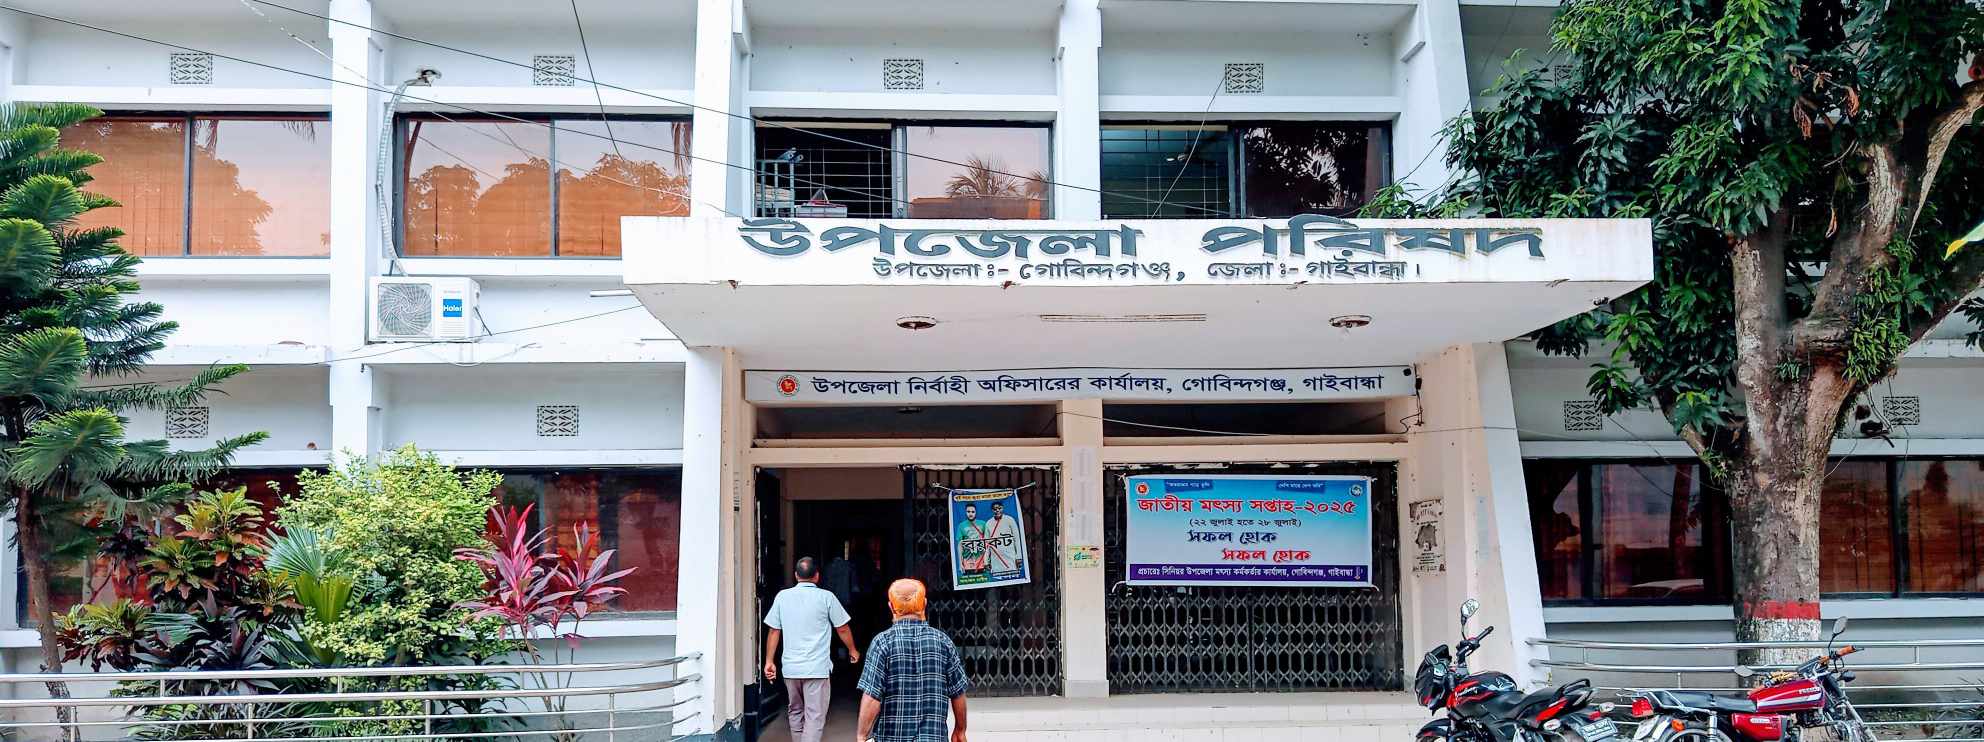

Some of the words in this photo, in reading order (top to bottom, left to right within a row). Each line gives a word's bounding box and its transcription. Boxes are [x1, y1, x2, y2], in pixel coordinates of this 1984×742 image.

[738, 217, 1144, 258] উপজেলা
[1201, 214, 1545, 259] পরিষদ
[811, 376, 899, 395] উপজেলা
[905, 376, 970, 395] নির্বাহী
[978, 375, 1080, 393] অফিসারের
[1089, 373, 1172, 394] কার্যালয়,
[1182, 374, 1293, 394] গোবিন্দগঞ্জ,
[1303, 373, 1385, 391] গাইবান্ধা
[1137, 494, 1193, 513] জাতীয়
[1200, 499, 1242, 513] মৎস্য
[1250, 499, 1357, 514] সপ্তাহ-২০২৫
[1187, 530, 1232, 543] সফল
[1239, 530, 1279, 544] হোক
[1221, 549, 1266, 561] সফল
[1272, 549, 1312, 563] হোক
[1186, 566, 1213, 576] উপজেলা
